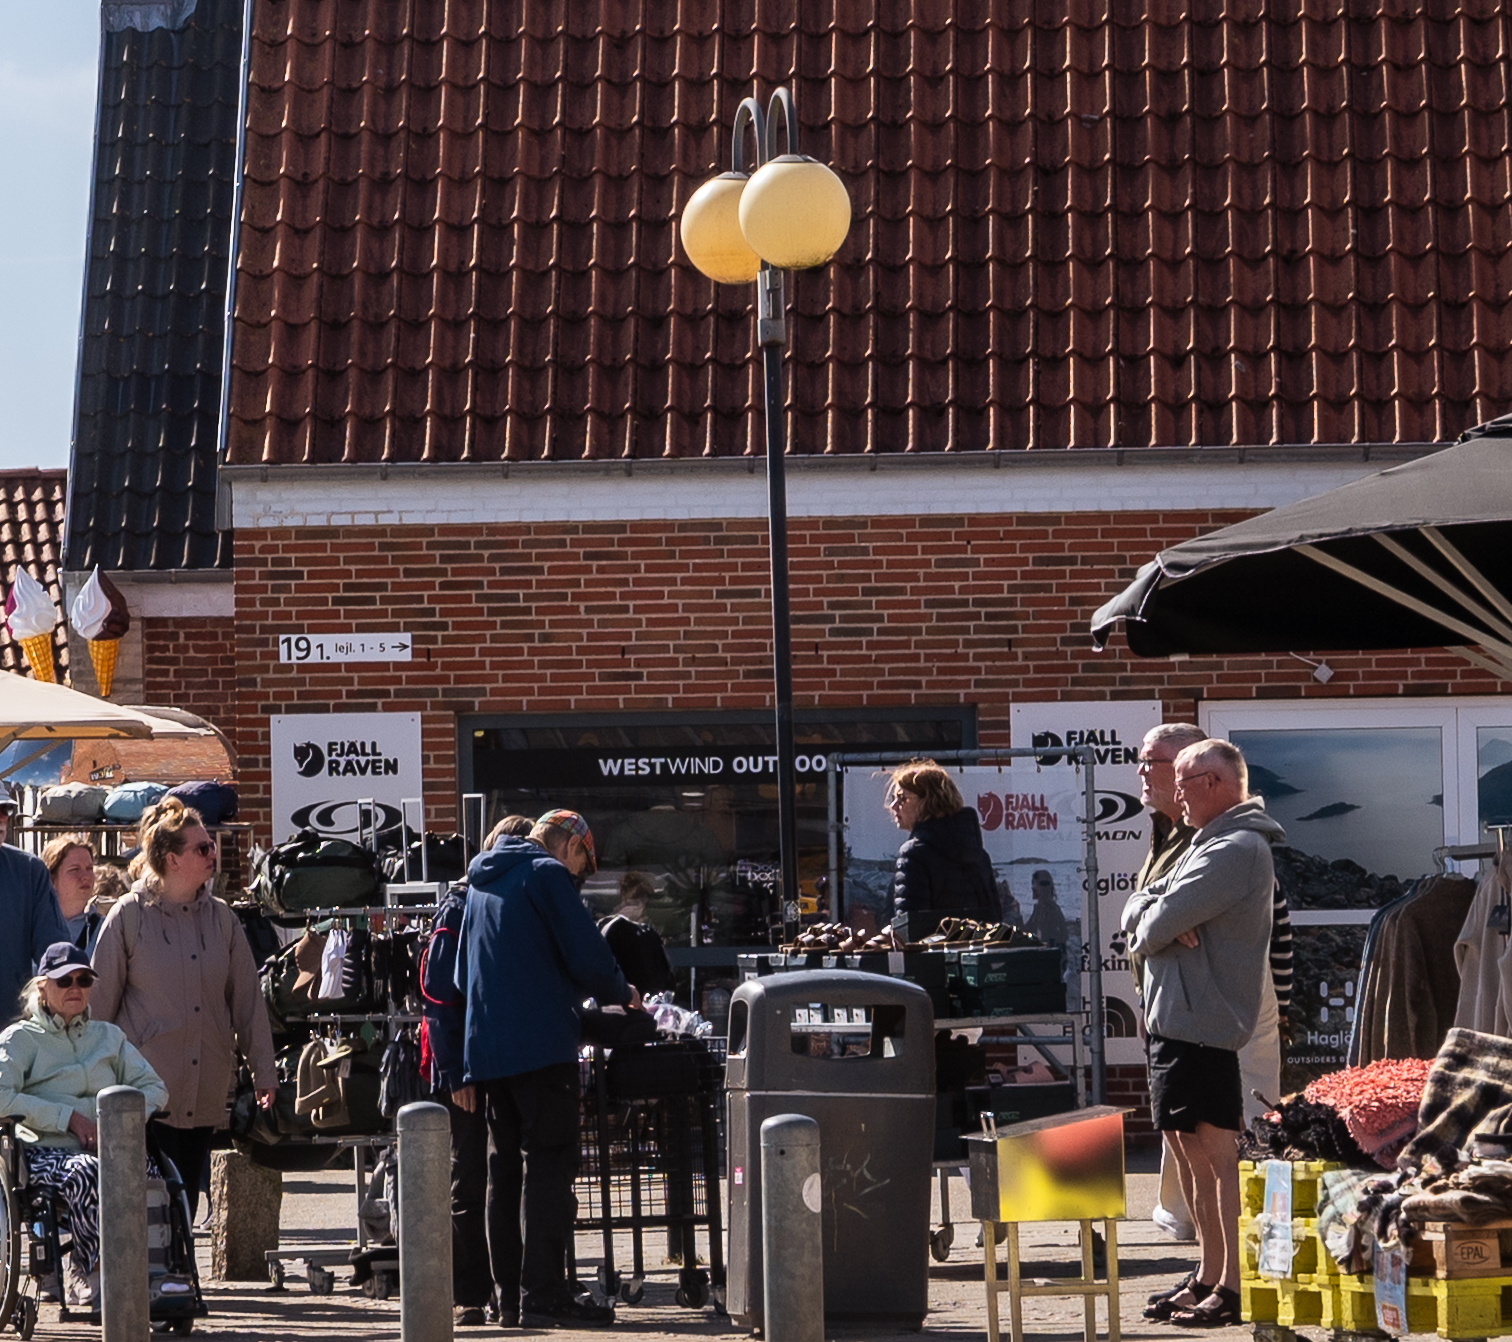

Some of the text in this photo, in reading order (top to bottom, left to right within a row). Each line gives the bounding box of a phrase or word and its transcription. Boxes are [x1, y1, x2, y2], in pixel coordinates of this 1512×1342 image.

[281, 636, 312, 661] 19
[315, 643, 331, 660] 1.
[334, 642, 356, 654] lejl.
[360, 643, 366, 653] 1
[379, 643, 386, 653] 5
[1066, 729, 1122, 746] FJÄLL
[327, 740, 382, 758] FJÄLL
[327, 758, 399, 777] RÄVEN
[598, 755, 841, 776] WESTWIND OUTOO
[1004, 793, 1049, 812] FJÄLL
[1004, 811, 1058, 831] RÄVEN
[1307, 1030, 1353, 1048] Haglö
[1287, 1056, 1337, 1064] OUTSIDERS
[1460, 1246, 1486, 1259] EPAL
